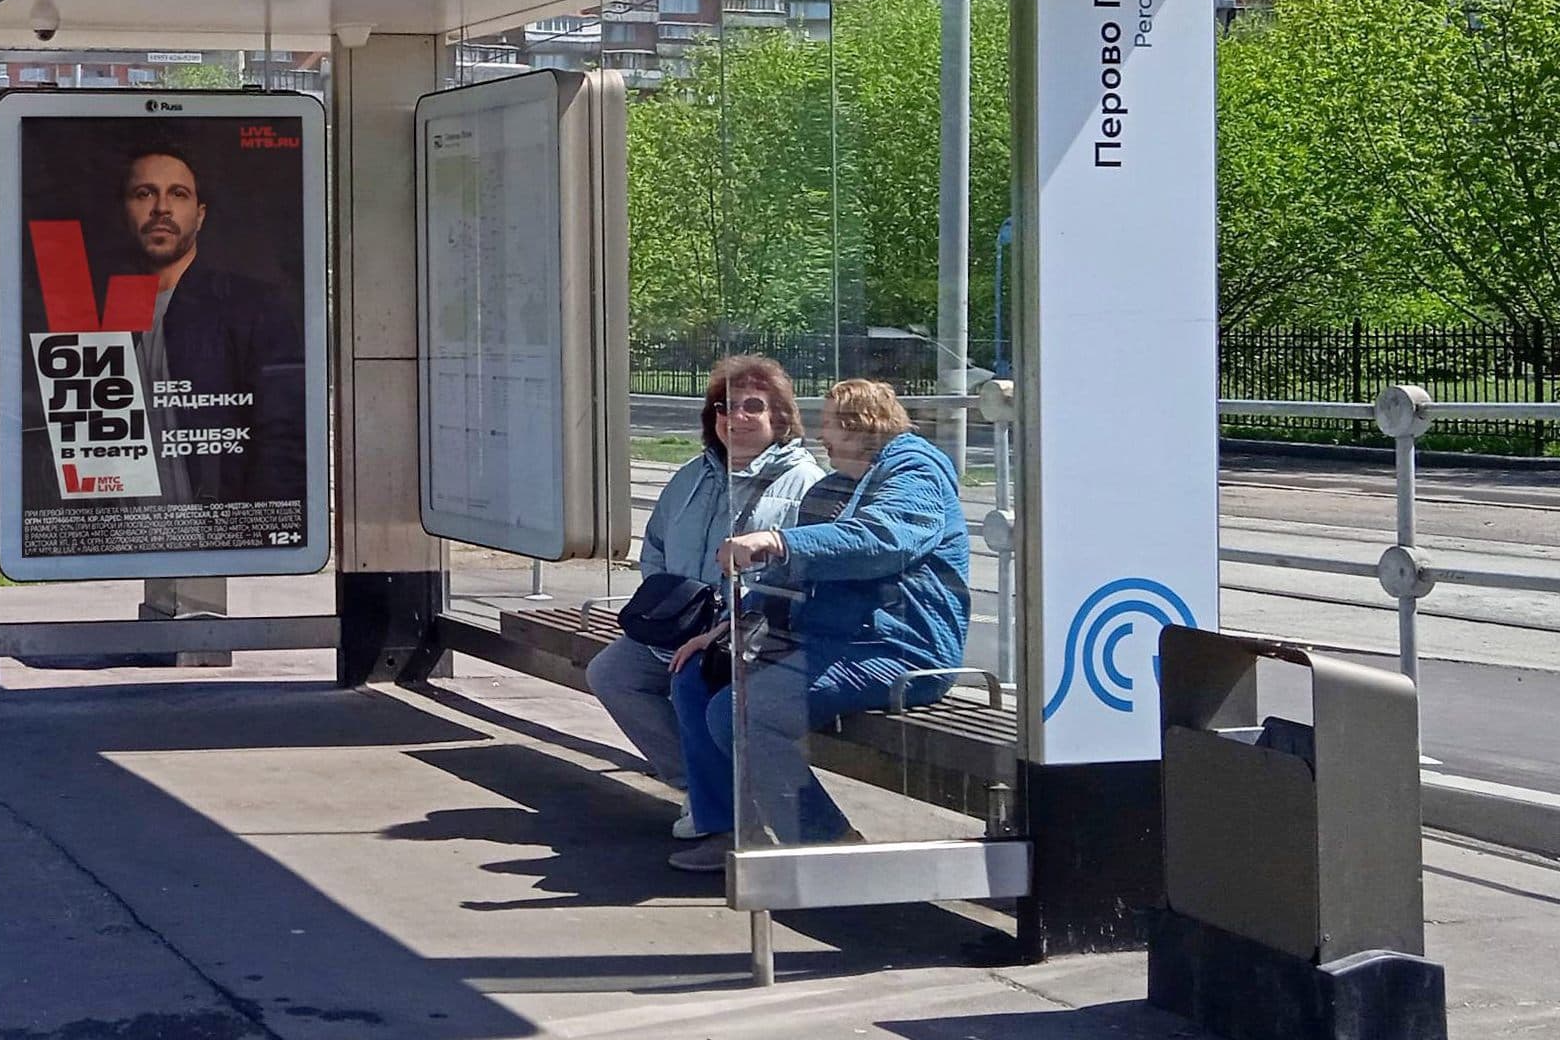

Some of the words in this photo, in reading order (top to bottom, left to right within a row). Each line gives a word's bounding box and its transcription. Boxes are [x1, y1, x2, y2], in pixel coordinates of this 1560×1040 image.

[1094, 22, 1128, 167] Перово
[241, 137, 299, 147] MTS.RU
[39, 334, 125, 378] би
[49, 377, 134, 410] ле
[153, 380, 192, 393] БЕЗ
[153, 393, 253, 408] НАЦЕНКИ
[49, 409, 144, 442] ты
[161, 427, 251, 442] КЕШБЭК
[61, 447, 75, 459] в
[80, 444, 148, 460] театр
[161, 443, 193, 458] ДО
[197, 441, 244, 455] 20%
[98, 476, 120, 484] МТС
[98, 484, 124, 492] LIVE
[268, 531, 302, 545] 12+
